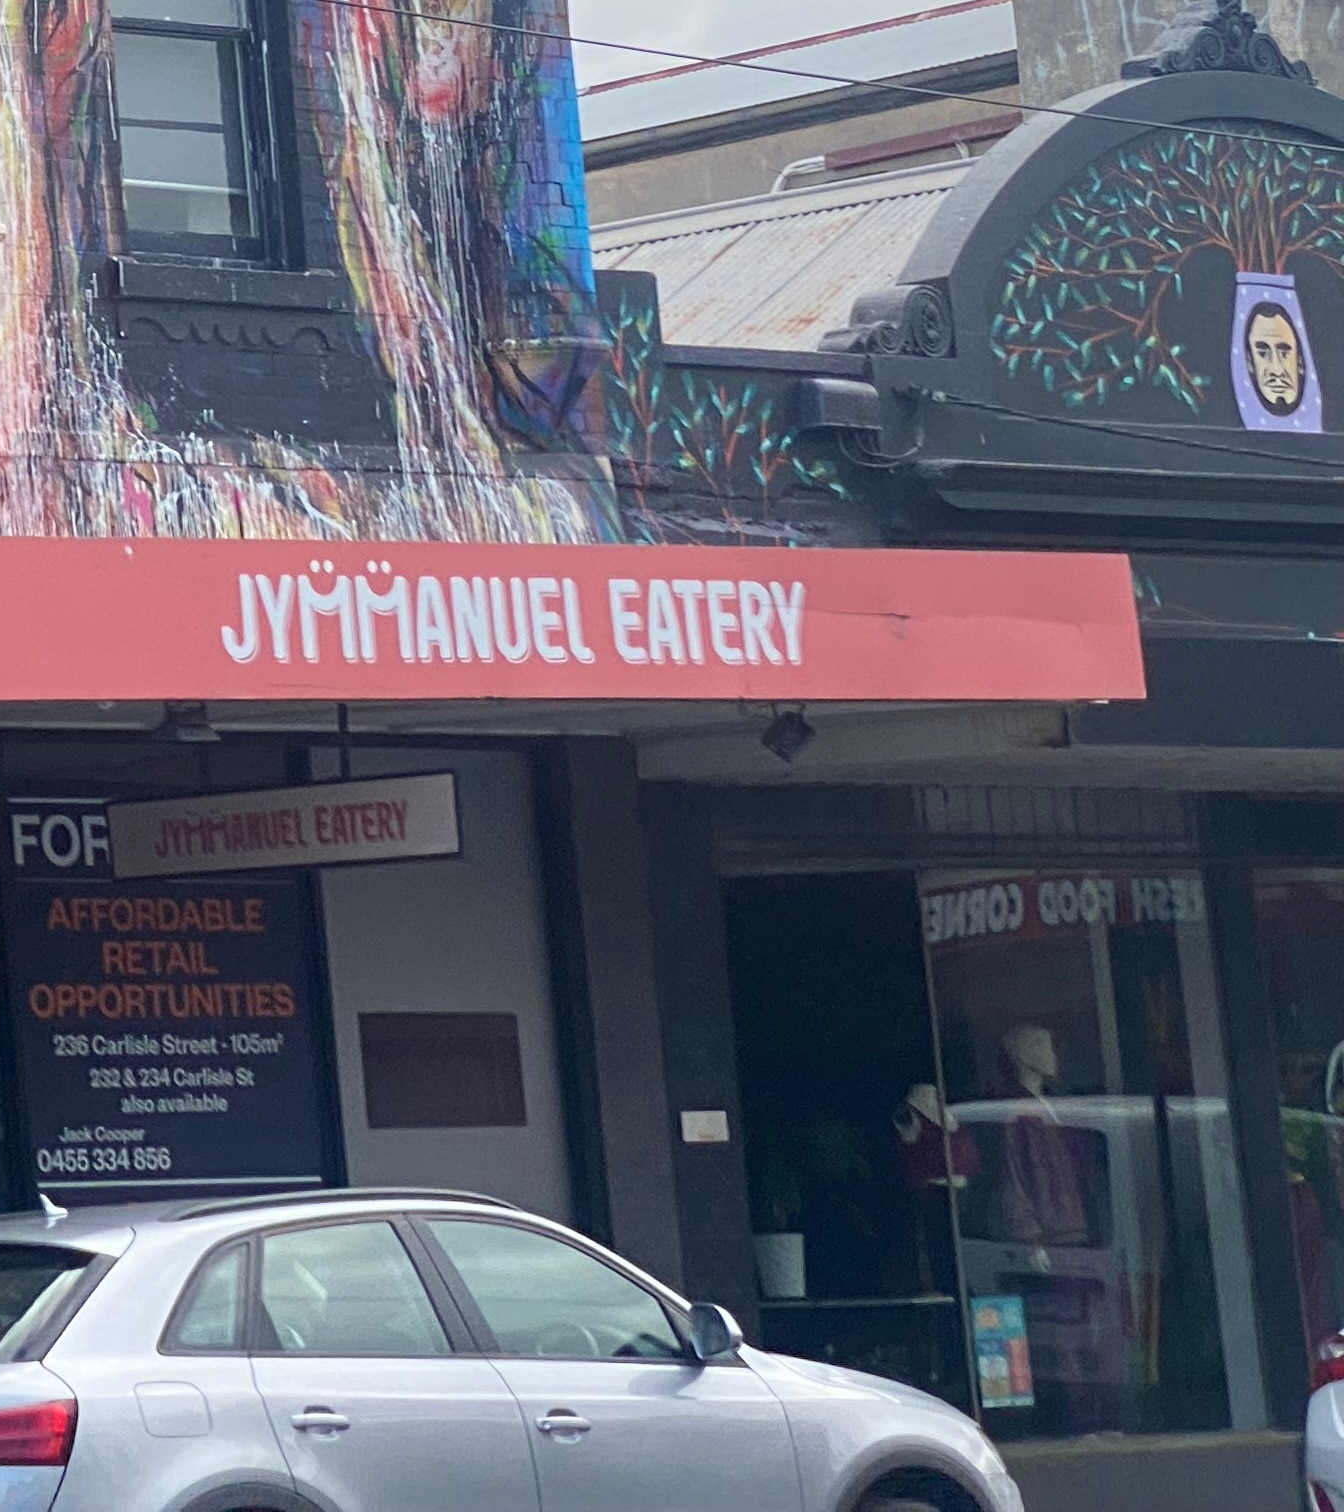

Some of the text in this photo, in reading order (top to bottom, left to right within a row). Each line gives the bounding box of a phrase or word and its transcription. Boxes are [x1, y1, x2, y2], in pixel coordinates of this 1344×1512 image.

[608, 578, 805, 665] EATERY
[313, 798, 408, 846] EATERY
[12, 813, 111, 868] FOR
[47, 896, 266, 932] AFFORDABLE
[101, 939, 220, 976] RETAIL
[28, 981, 296, 1020] OPPORTUNITIES
[53, 1034, 89, 1057] 236
[92, 1034, 161, 1056] Carlisle
[162, 1033, 218, 1055] Street
[89, 1065, 255, 1088] 232 & 234 Carlisle St
[120, 1092, 229, 1113] also available
[58, 1125, 146, 1145] Jack Cooper
[36, 1146, 173, 1173] 0455 334 856
